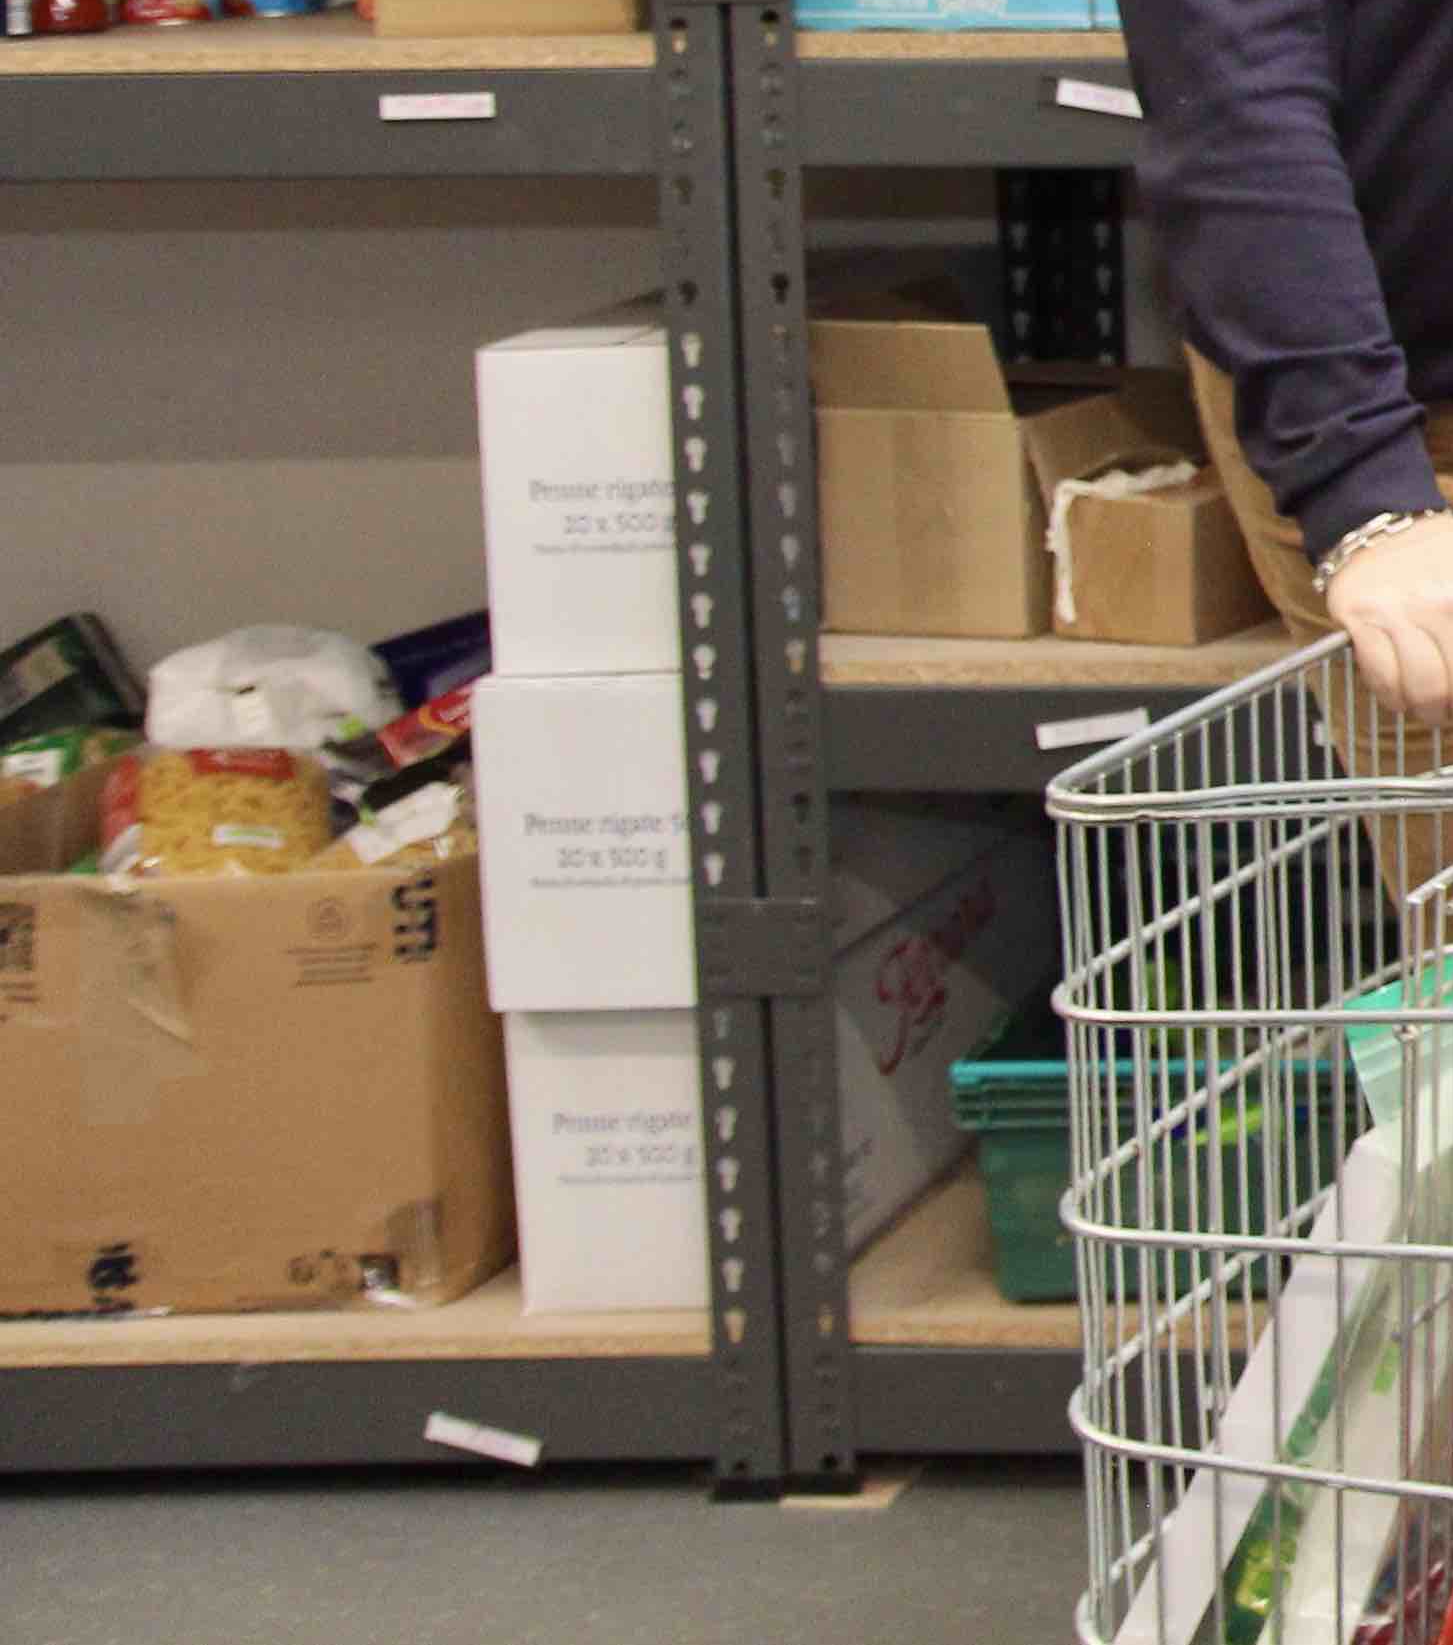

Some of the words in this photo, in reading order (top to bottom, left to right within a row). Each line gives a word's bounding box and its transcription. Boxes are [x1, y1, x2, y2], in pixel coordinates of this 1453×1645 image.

[528, 479, 599, 502] Penne
[523, 812, 592, 836] Penne
[552, 1111, 619, 1134] Penne
